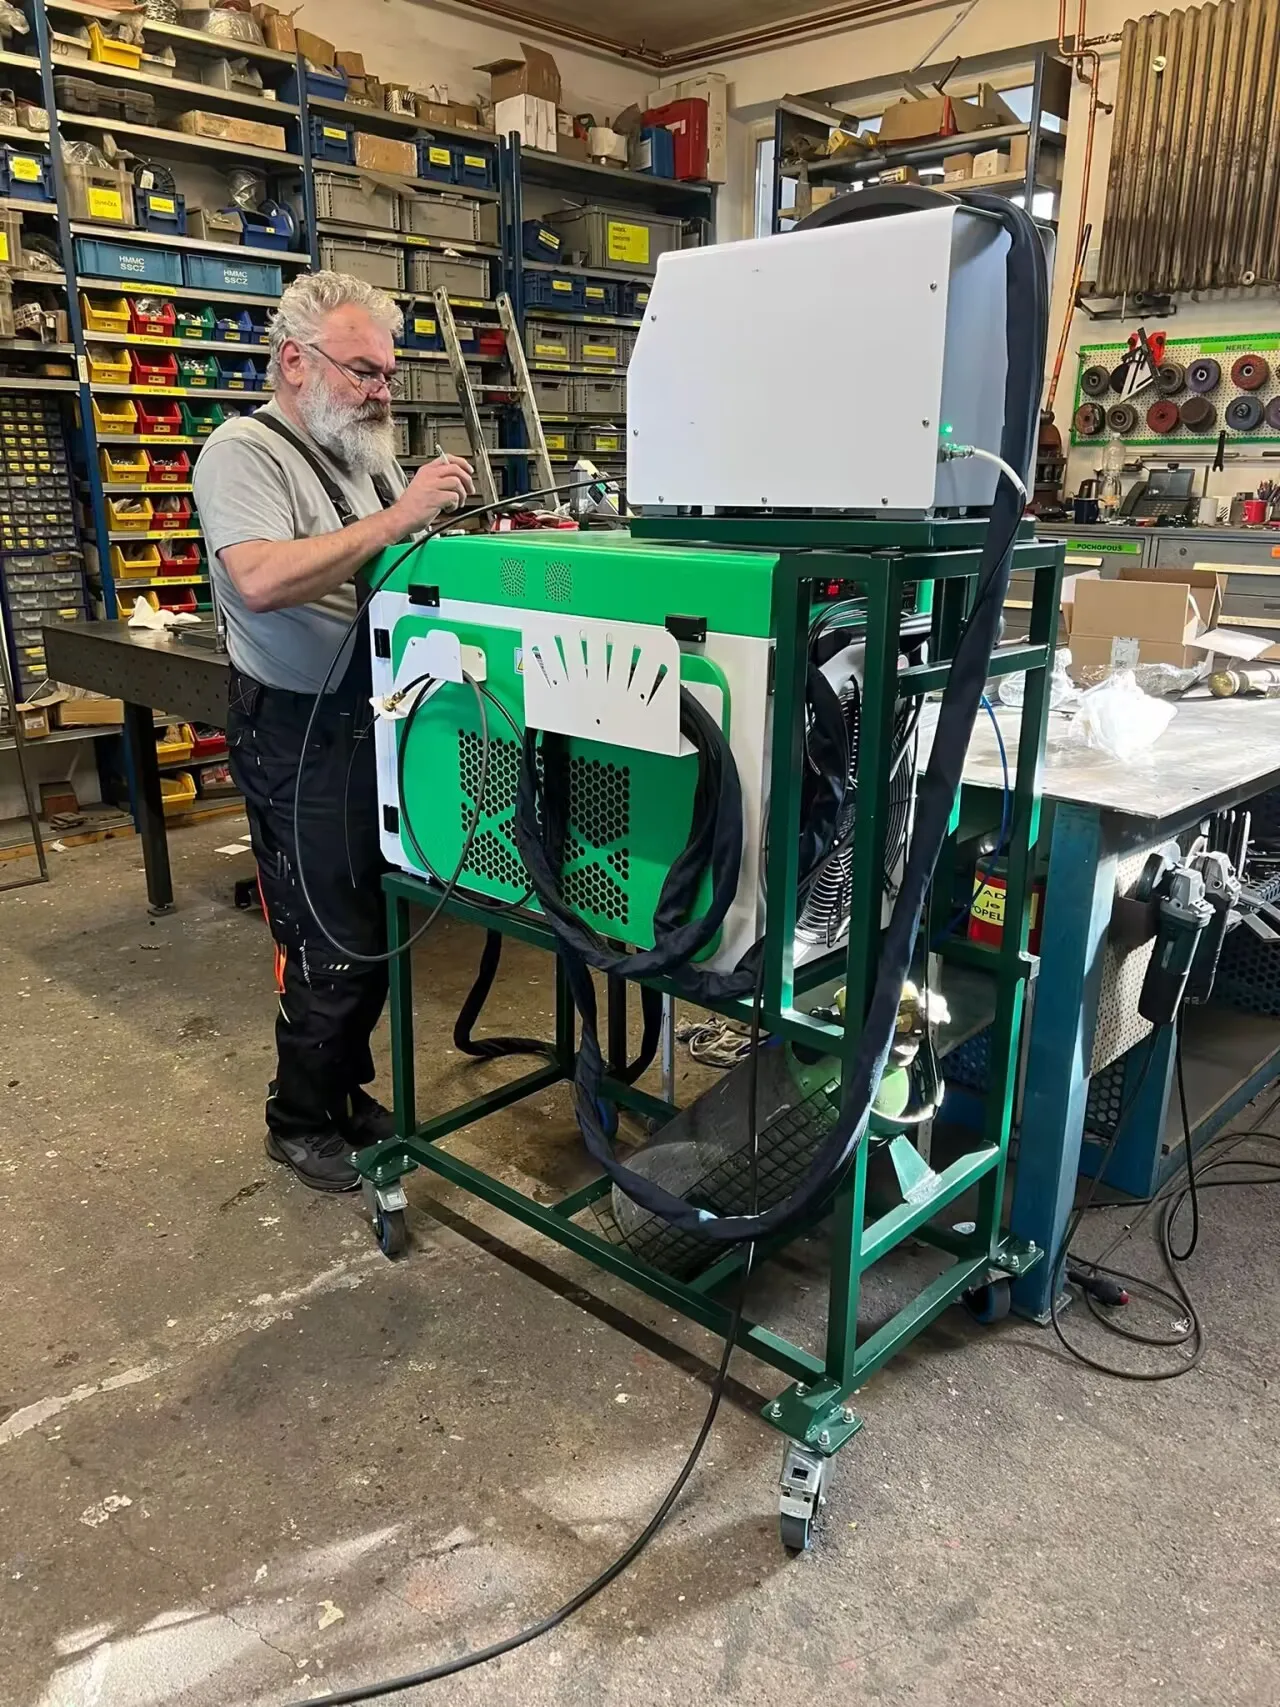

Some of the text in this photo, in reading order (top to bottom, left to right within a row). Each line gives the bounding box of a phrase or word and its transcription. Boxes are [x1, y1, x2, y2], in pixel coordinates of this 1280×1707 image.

[119, 255, 145, 266] HMMC
[120, 263, 146, 273] SSCZ
[223, 269, 248, 279] HMMC
[224, 276, 248, 285] SSCZ
[1225, 343, 1253, 351] NEREZ
[985, 900, 1000, 909] je
